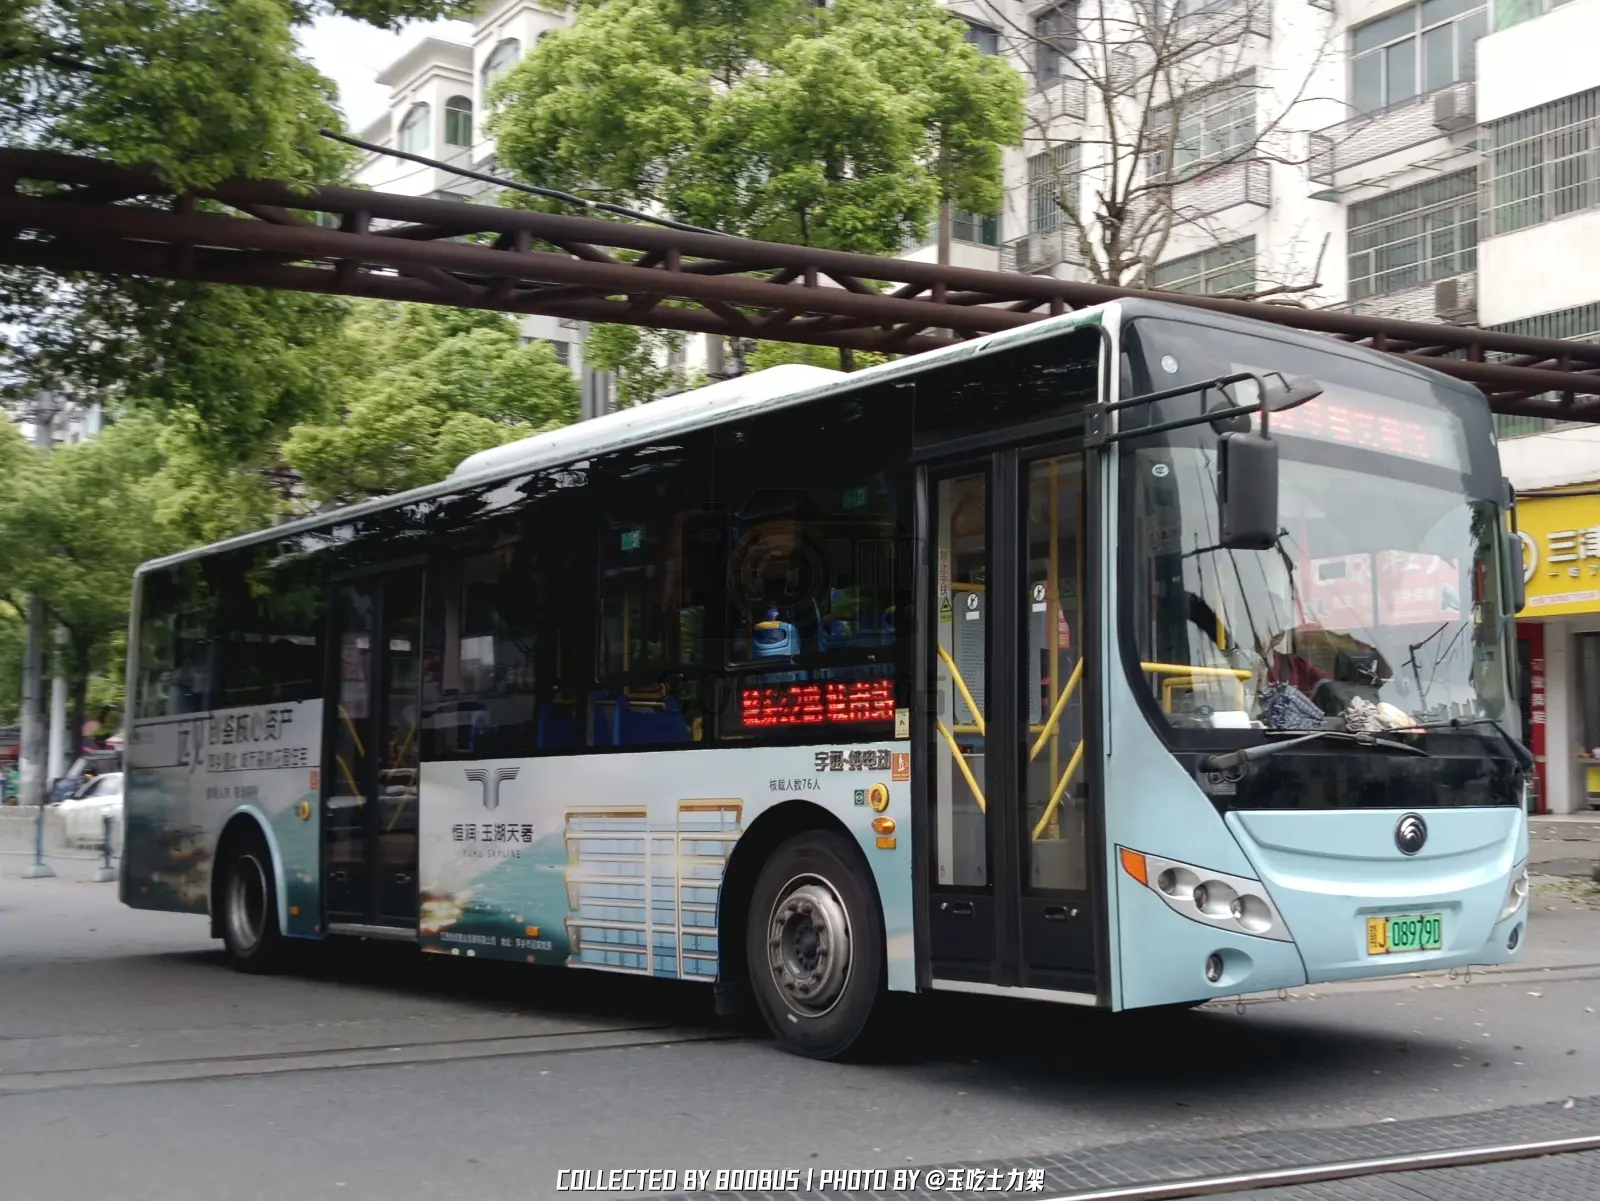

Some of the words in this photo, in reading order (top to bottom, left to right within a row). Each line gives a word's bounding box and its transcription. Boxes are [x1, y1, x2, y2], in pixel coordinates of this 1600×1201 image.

[769, 778, 821, 791] 核载人数76人
